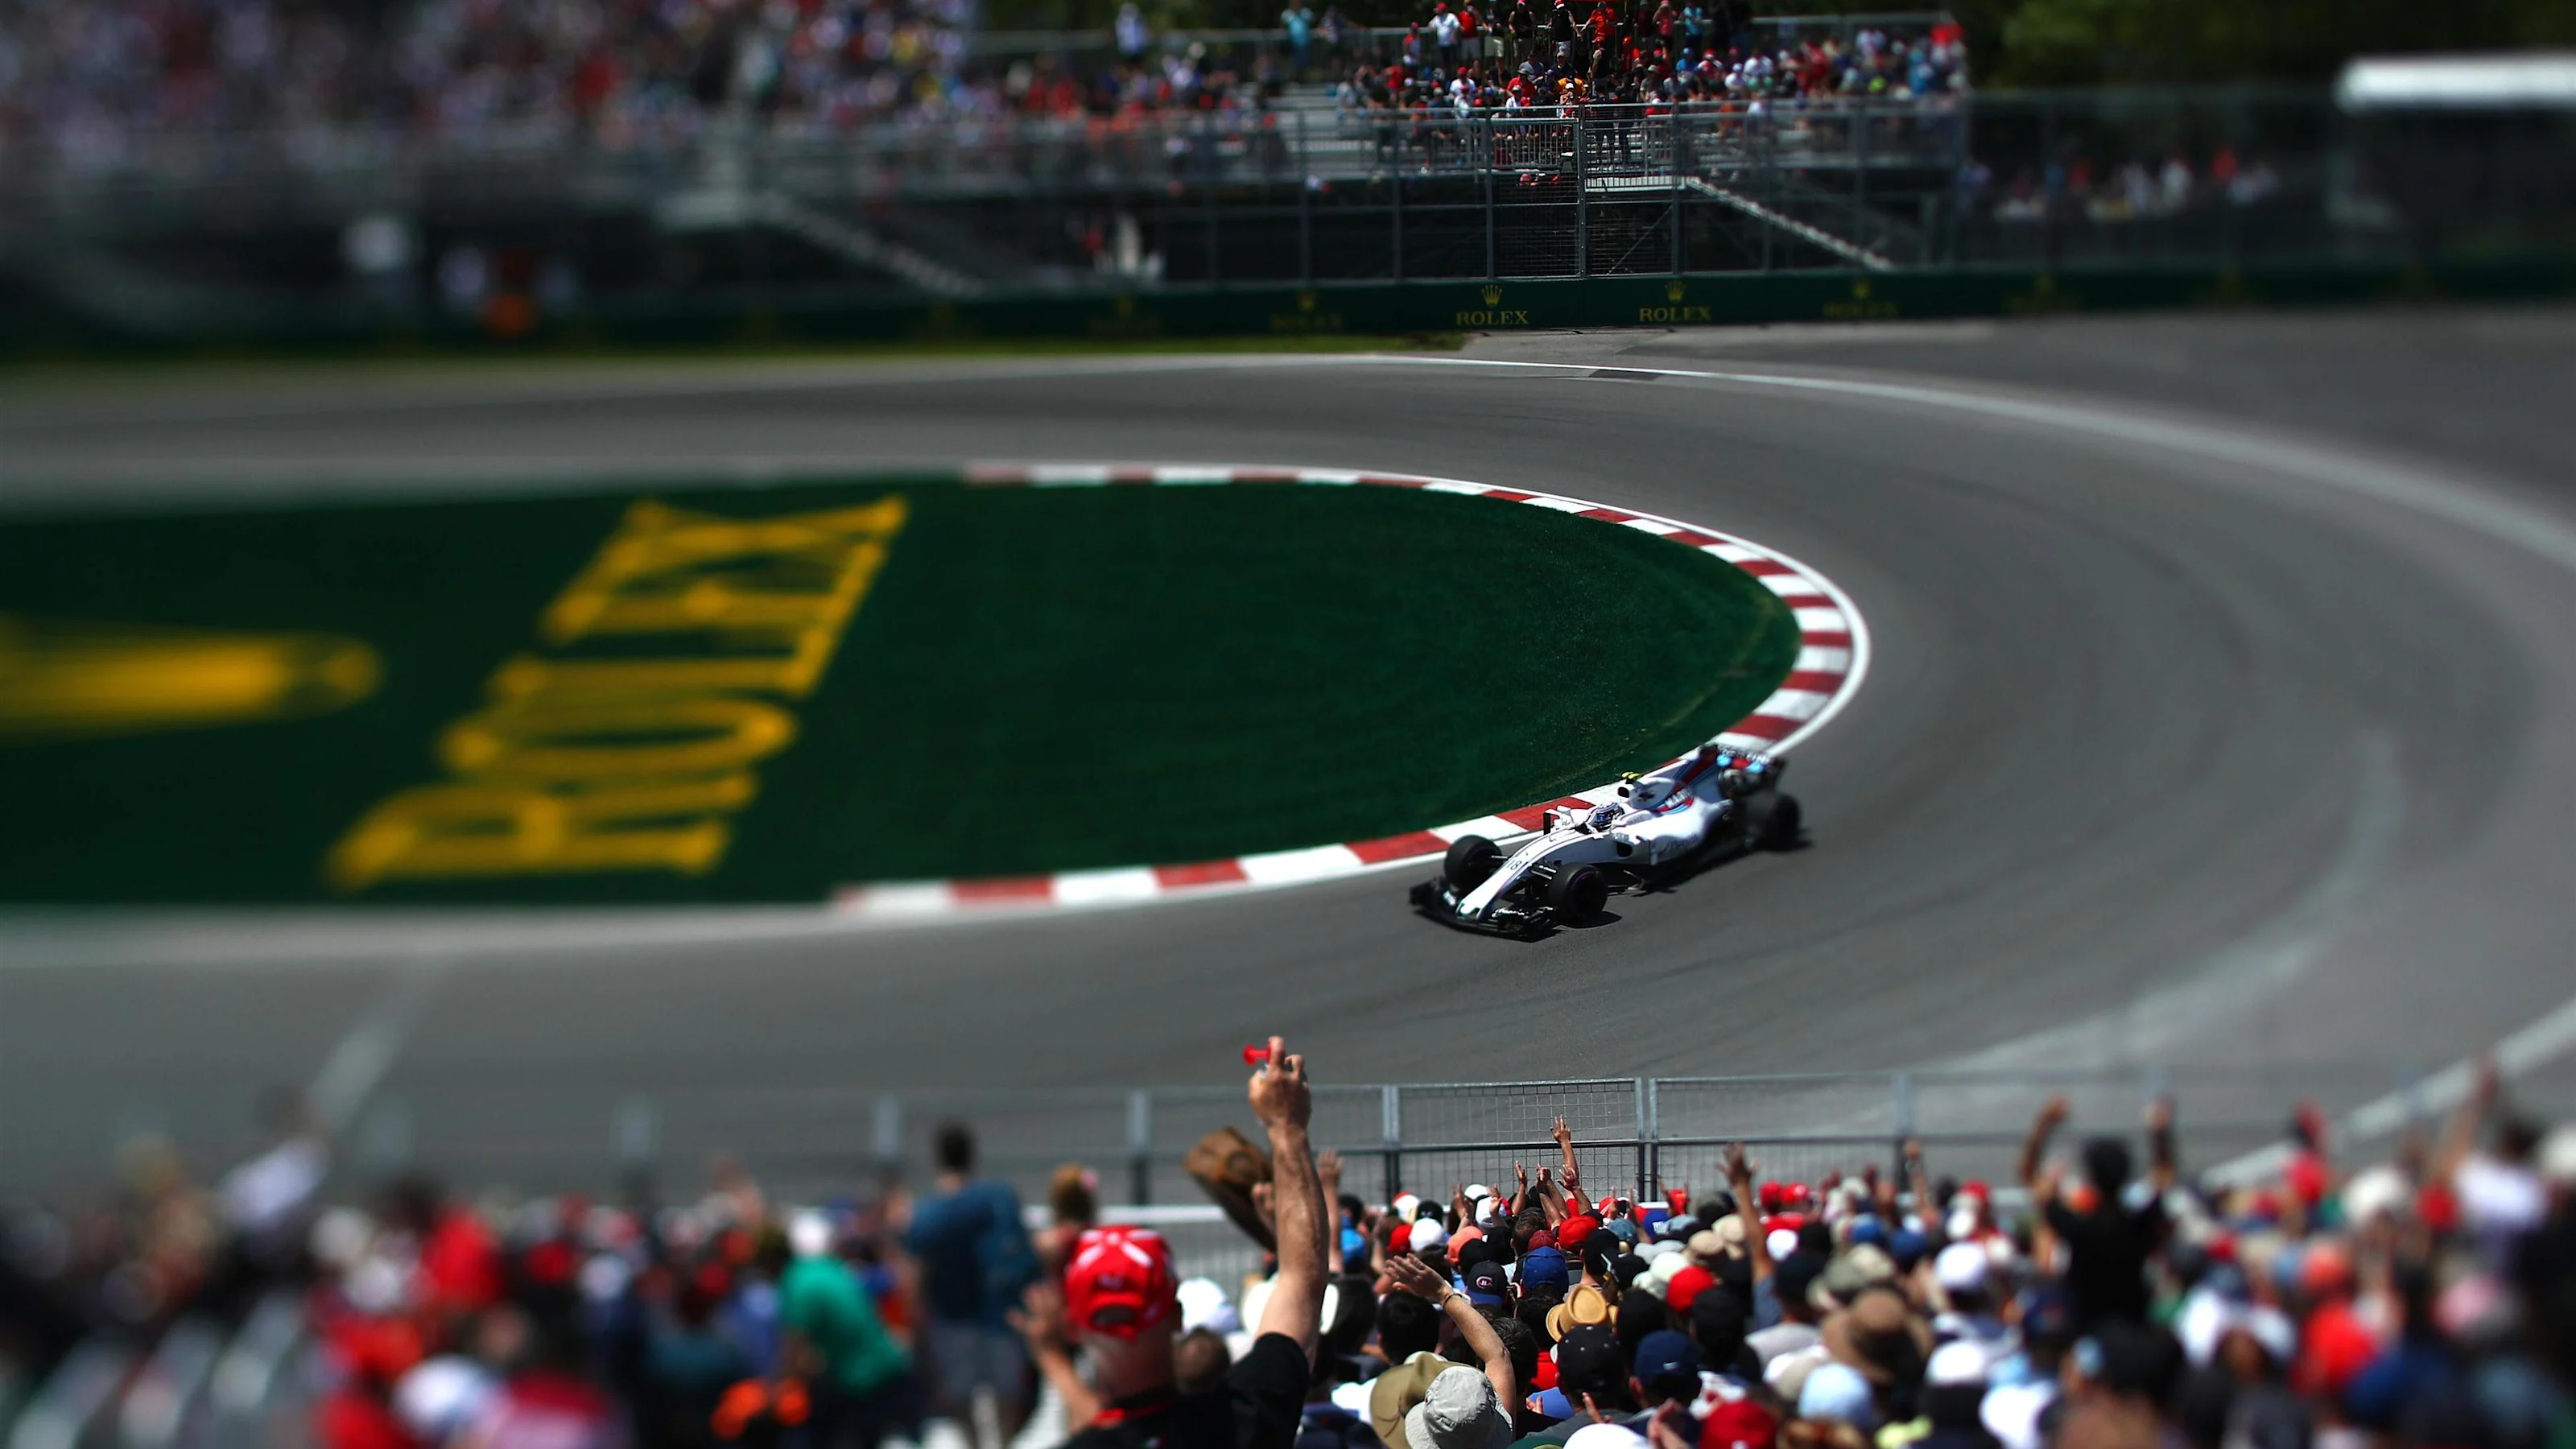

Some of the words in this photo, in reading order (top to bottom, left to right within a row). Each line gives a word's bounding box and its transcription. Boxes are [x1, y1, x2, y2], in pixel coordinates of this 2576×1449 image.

[1455, 310, 1530, 326] ROLEX
[1639, 306, 1712, 322] ROLEX
[333, 497, 907, 885] ROLEX
[1506, 859, 1522, 870] 18
